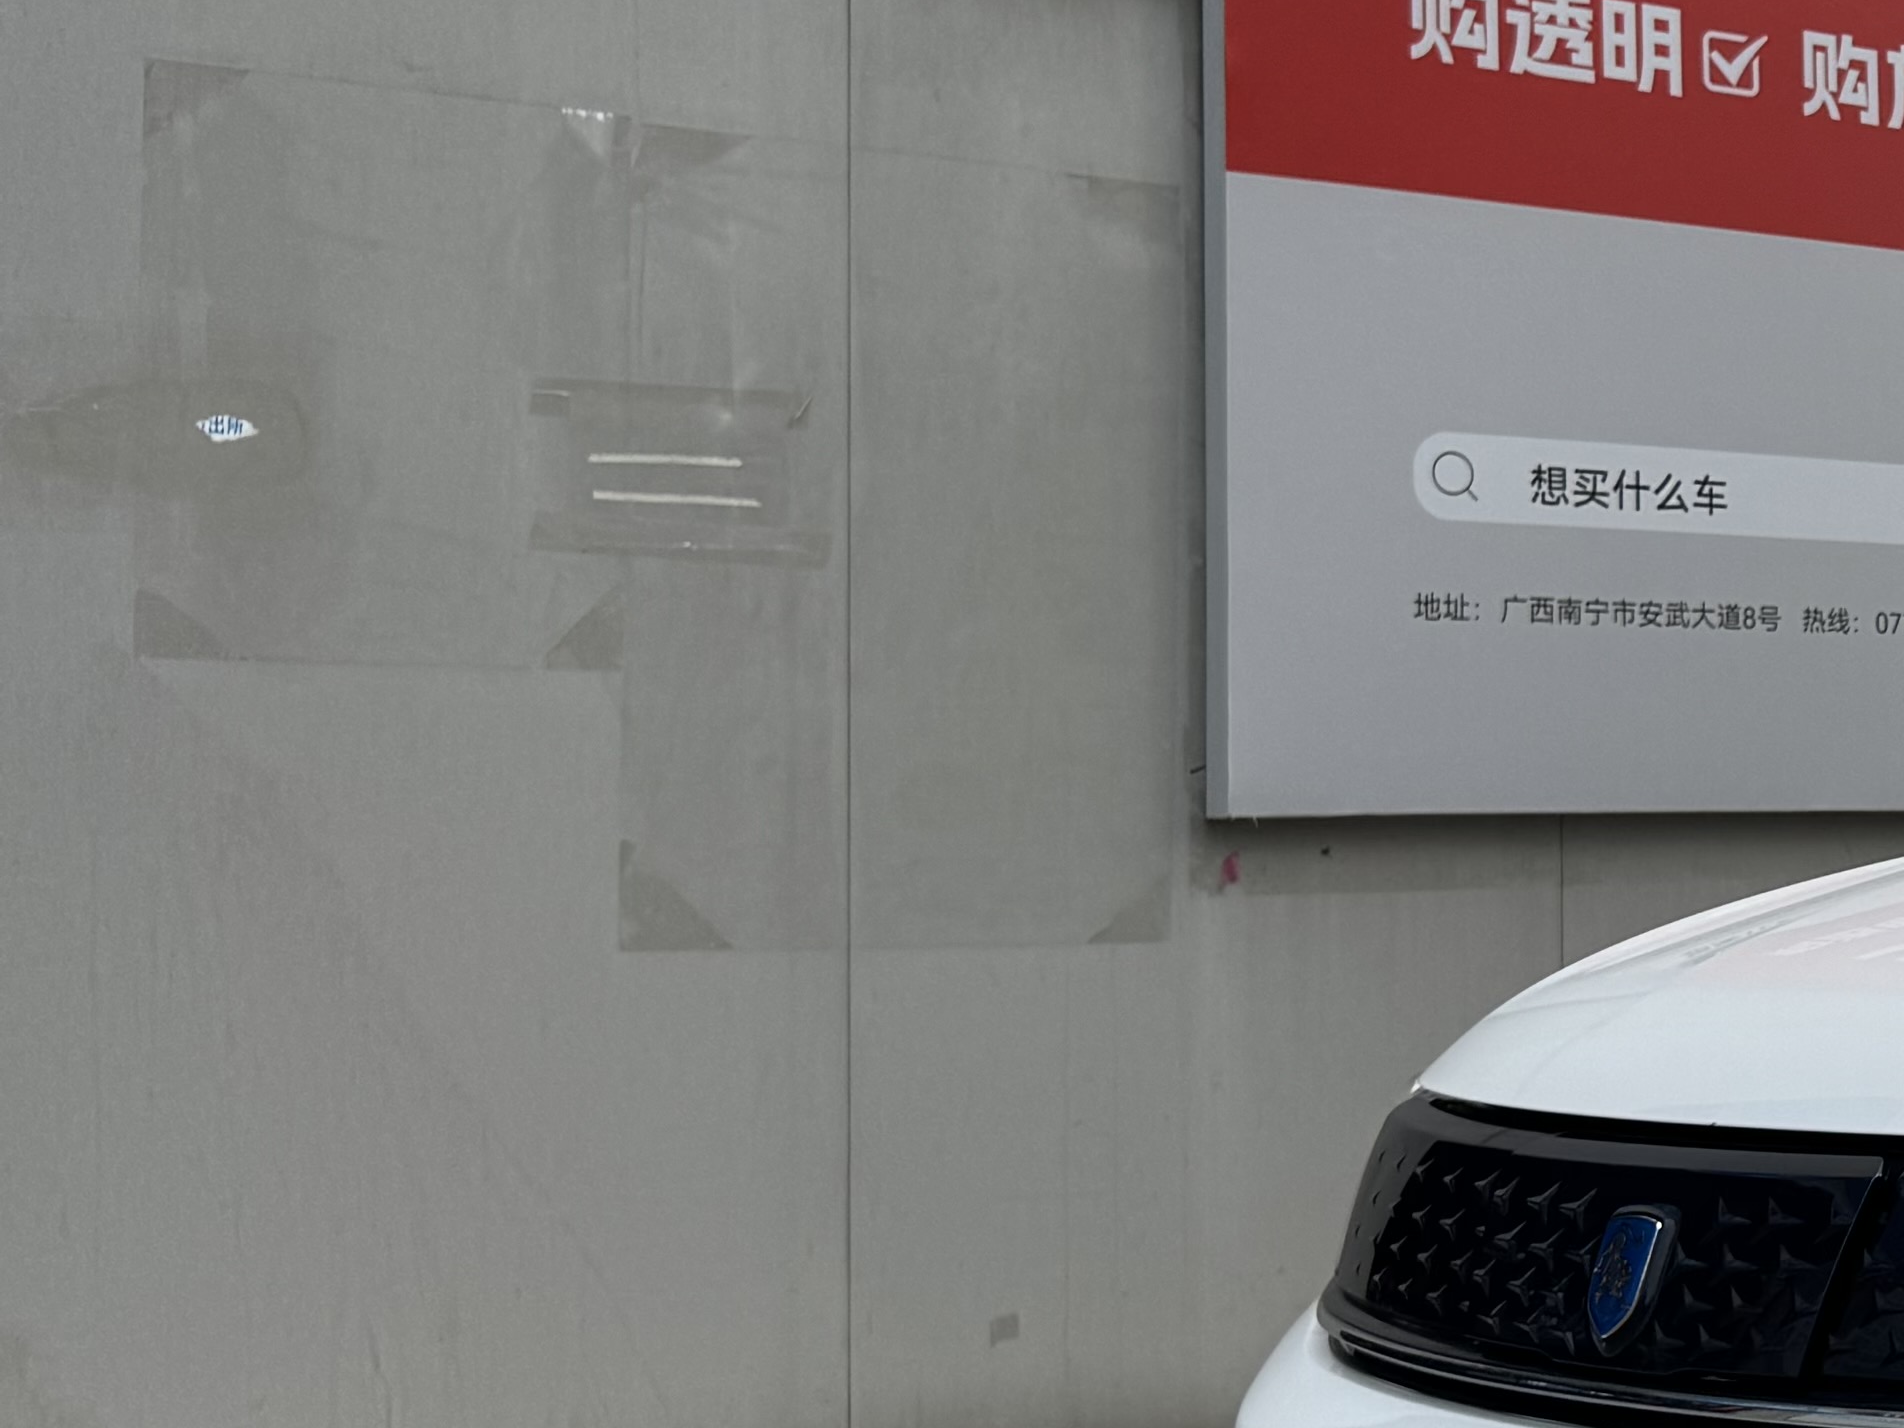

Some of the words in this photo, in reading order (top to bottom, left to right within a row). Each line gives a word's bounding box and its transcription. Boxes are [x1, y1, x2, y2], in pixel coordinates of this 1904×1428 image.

[1530, 463, 1730, 516] 想买什么车
[1500, 595, 1783, 634] 广西南宁市安武大道8号
